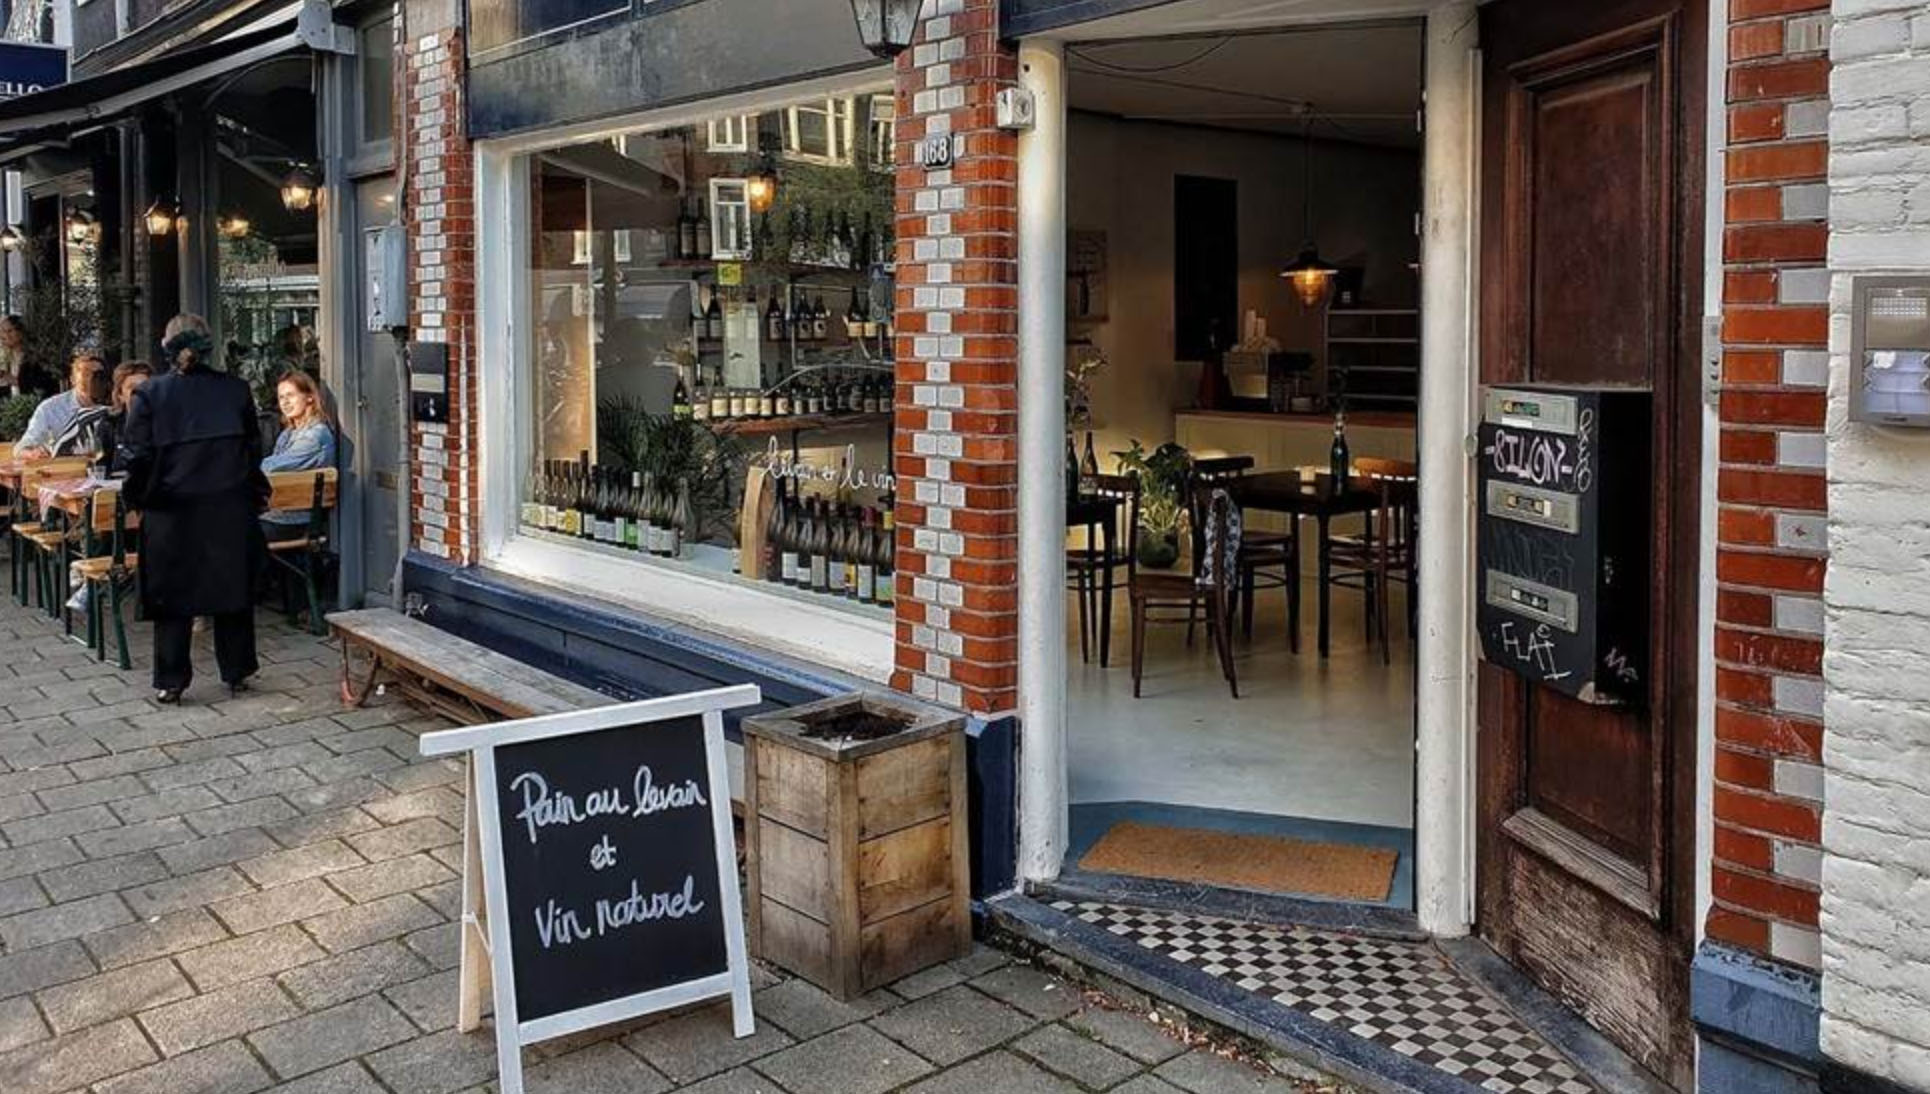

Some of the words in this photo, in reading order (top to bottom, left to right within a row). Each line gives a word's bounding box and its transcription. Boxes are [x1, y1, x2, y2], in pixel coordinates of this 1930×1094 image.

[925, 137, 948, 164] 168
[510, 772, 586, 844] Pain
[586, 787, 629, 816] au
[633, 765, 707, 818] levain
[590, 834, 616, 870] et
[535, 899, 591, 948] Vin
[596, 875, 704, 936] naturel
